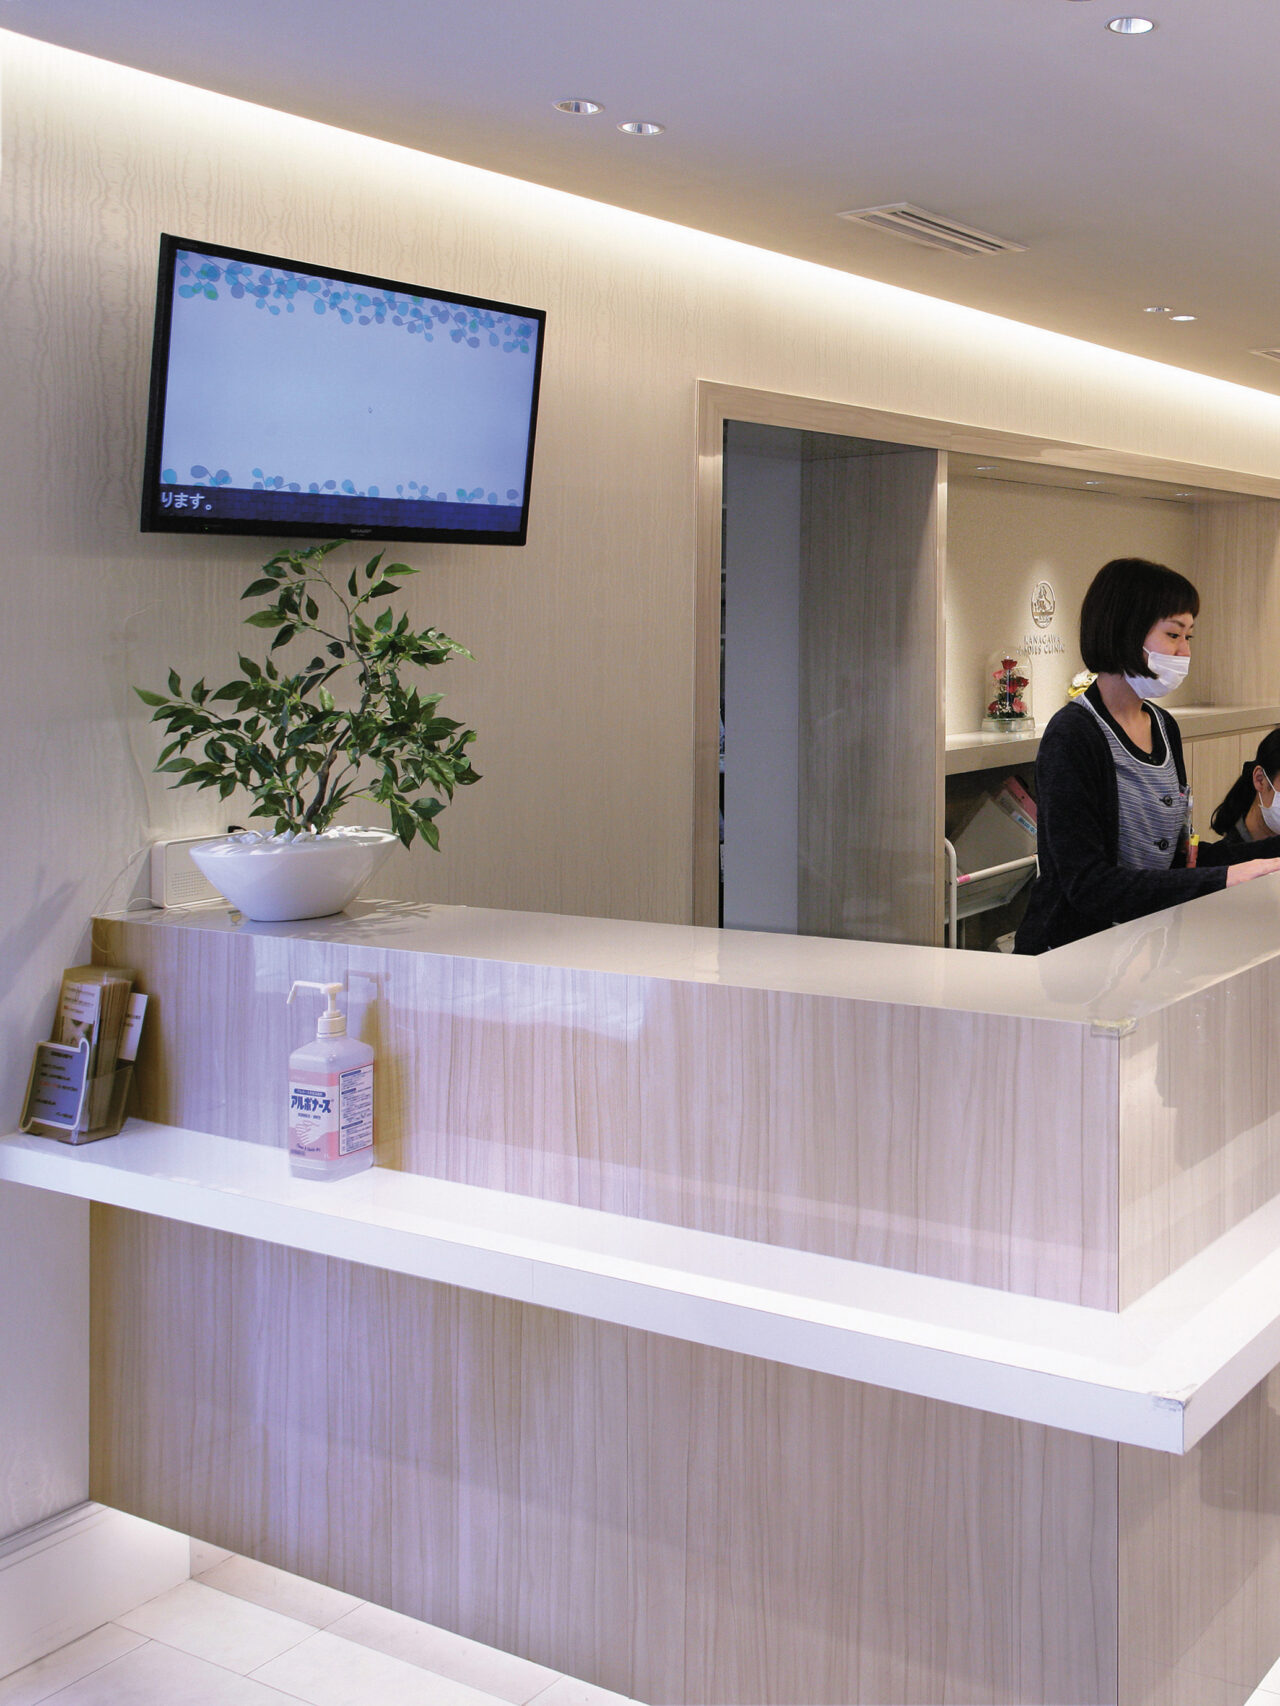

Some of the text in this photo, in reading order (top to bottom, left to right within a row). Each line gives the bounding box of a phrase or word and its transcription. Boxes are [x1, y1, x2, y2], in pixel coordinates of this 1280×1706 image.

[161, 491, 212, 511] ります。
[291, 1095, 332, 1114] アルボナース
